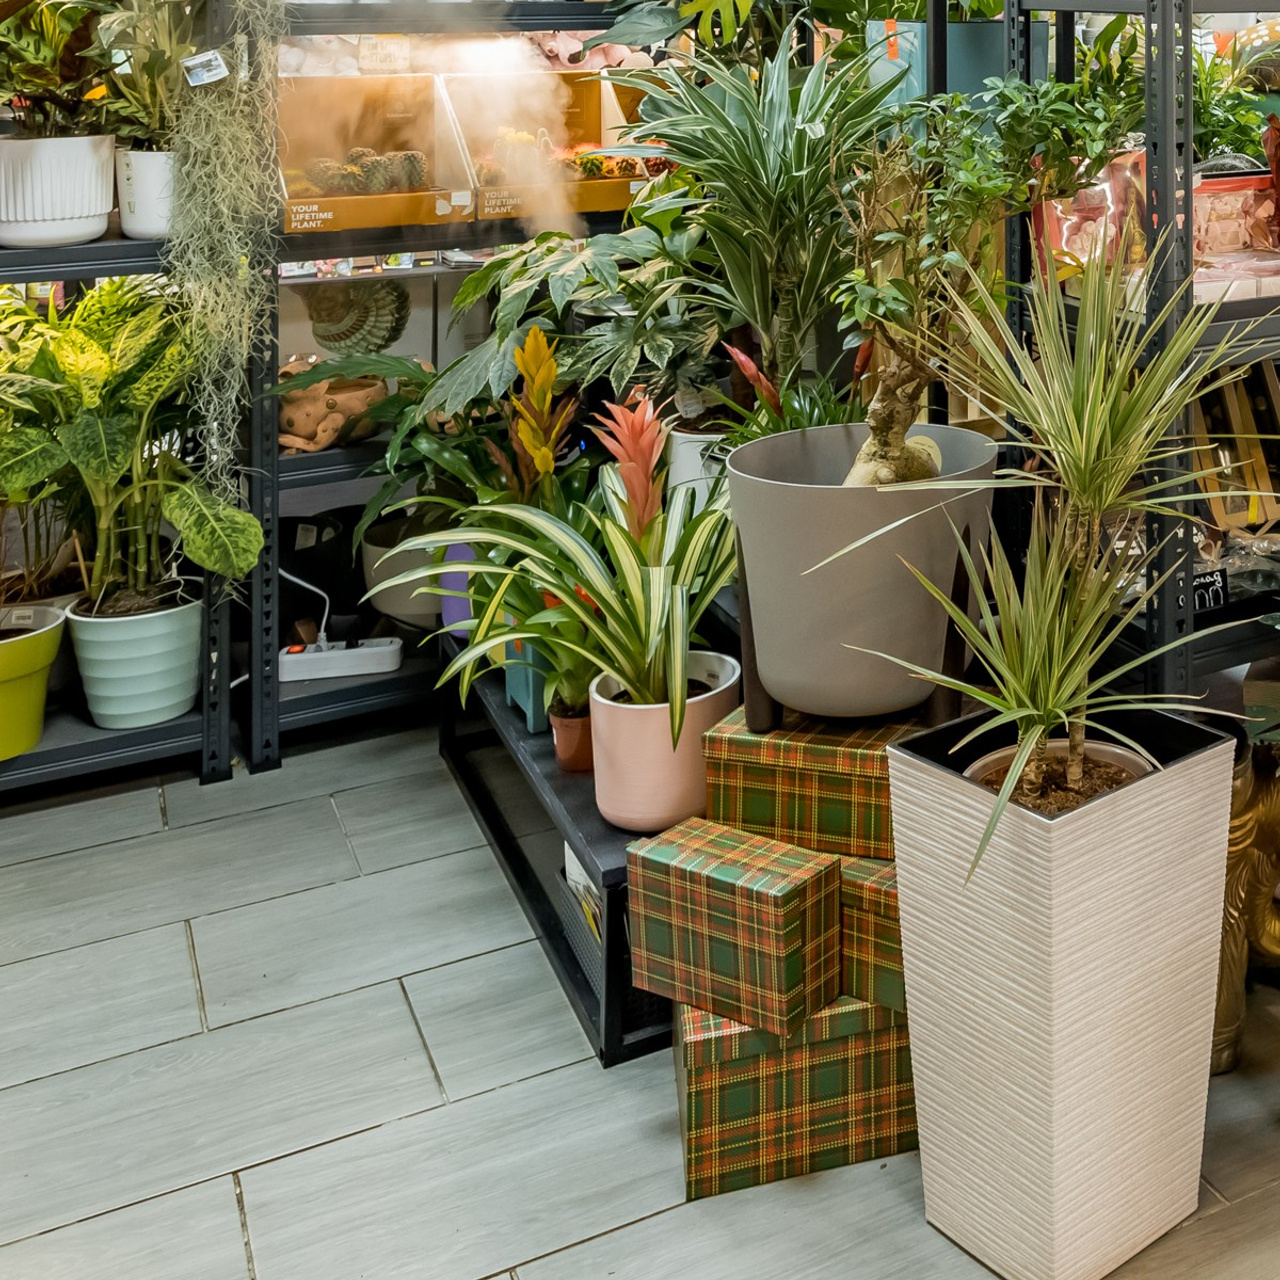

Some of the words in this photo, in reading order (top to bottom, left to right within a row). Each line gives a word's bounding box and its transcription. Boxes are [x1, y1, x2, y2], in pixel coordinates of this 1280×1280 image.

[484, 191, 510, 199] YOUR
[484, 198, 522, 206] LIFETIME
[291, 204, 319, 213] YOUR
[484, 206, 515, 214] PLANT.
[291, 211, 334, 221] LIFETIME
[291, 220, 324, 229] PLANT.
